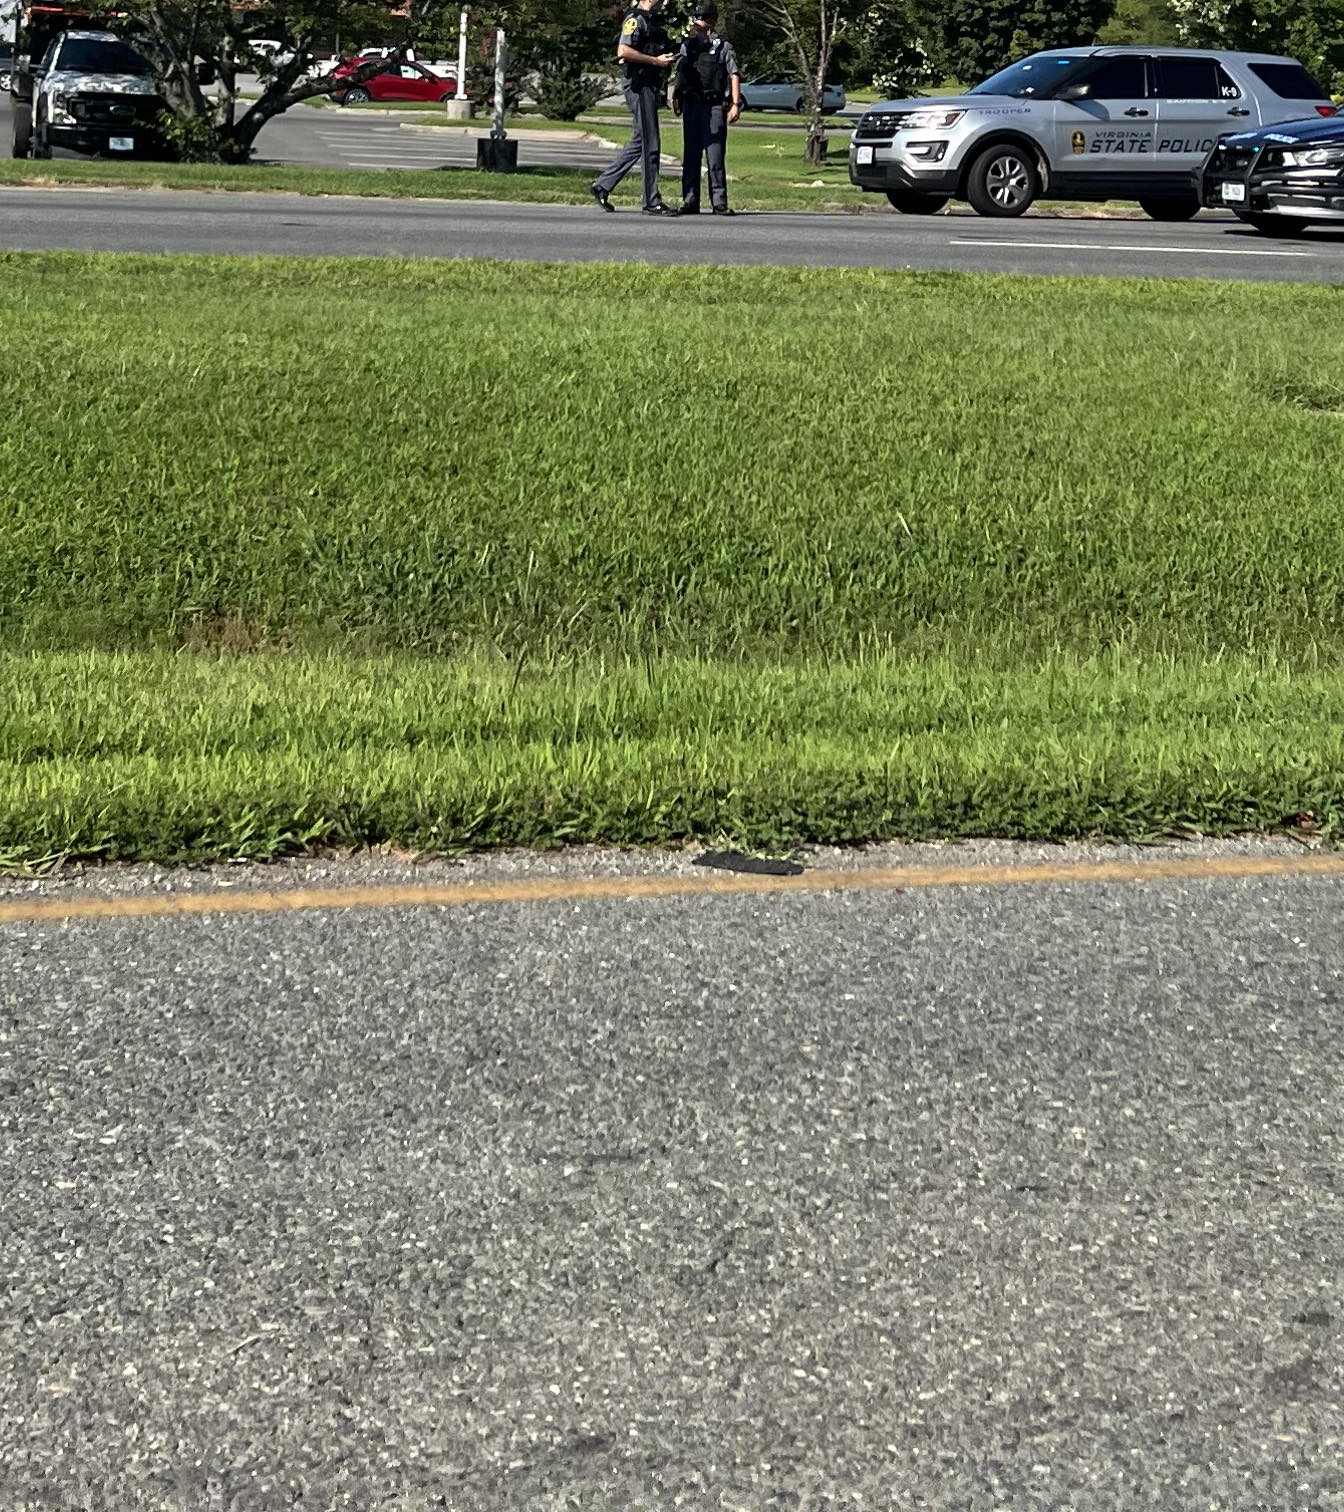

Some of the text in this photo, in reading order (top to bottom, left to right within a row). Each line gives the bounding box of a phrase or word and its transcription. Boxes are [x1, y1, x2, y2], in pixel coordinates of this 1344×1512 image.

[1221, 86, 1237, 97] K-9
[1090, 139, 1216, 153] STATE POLIC
